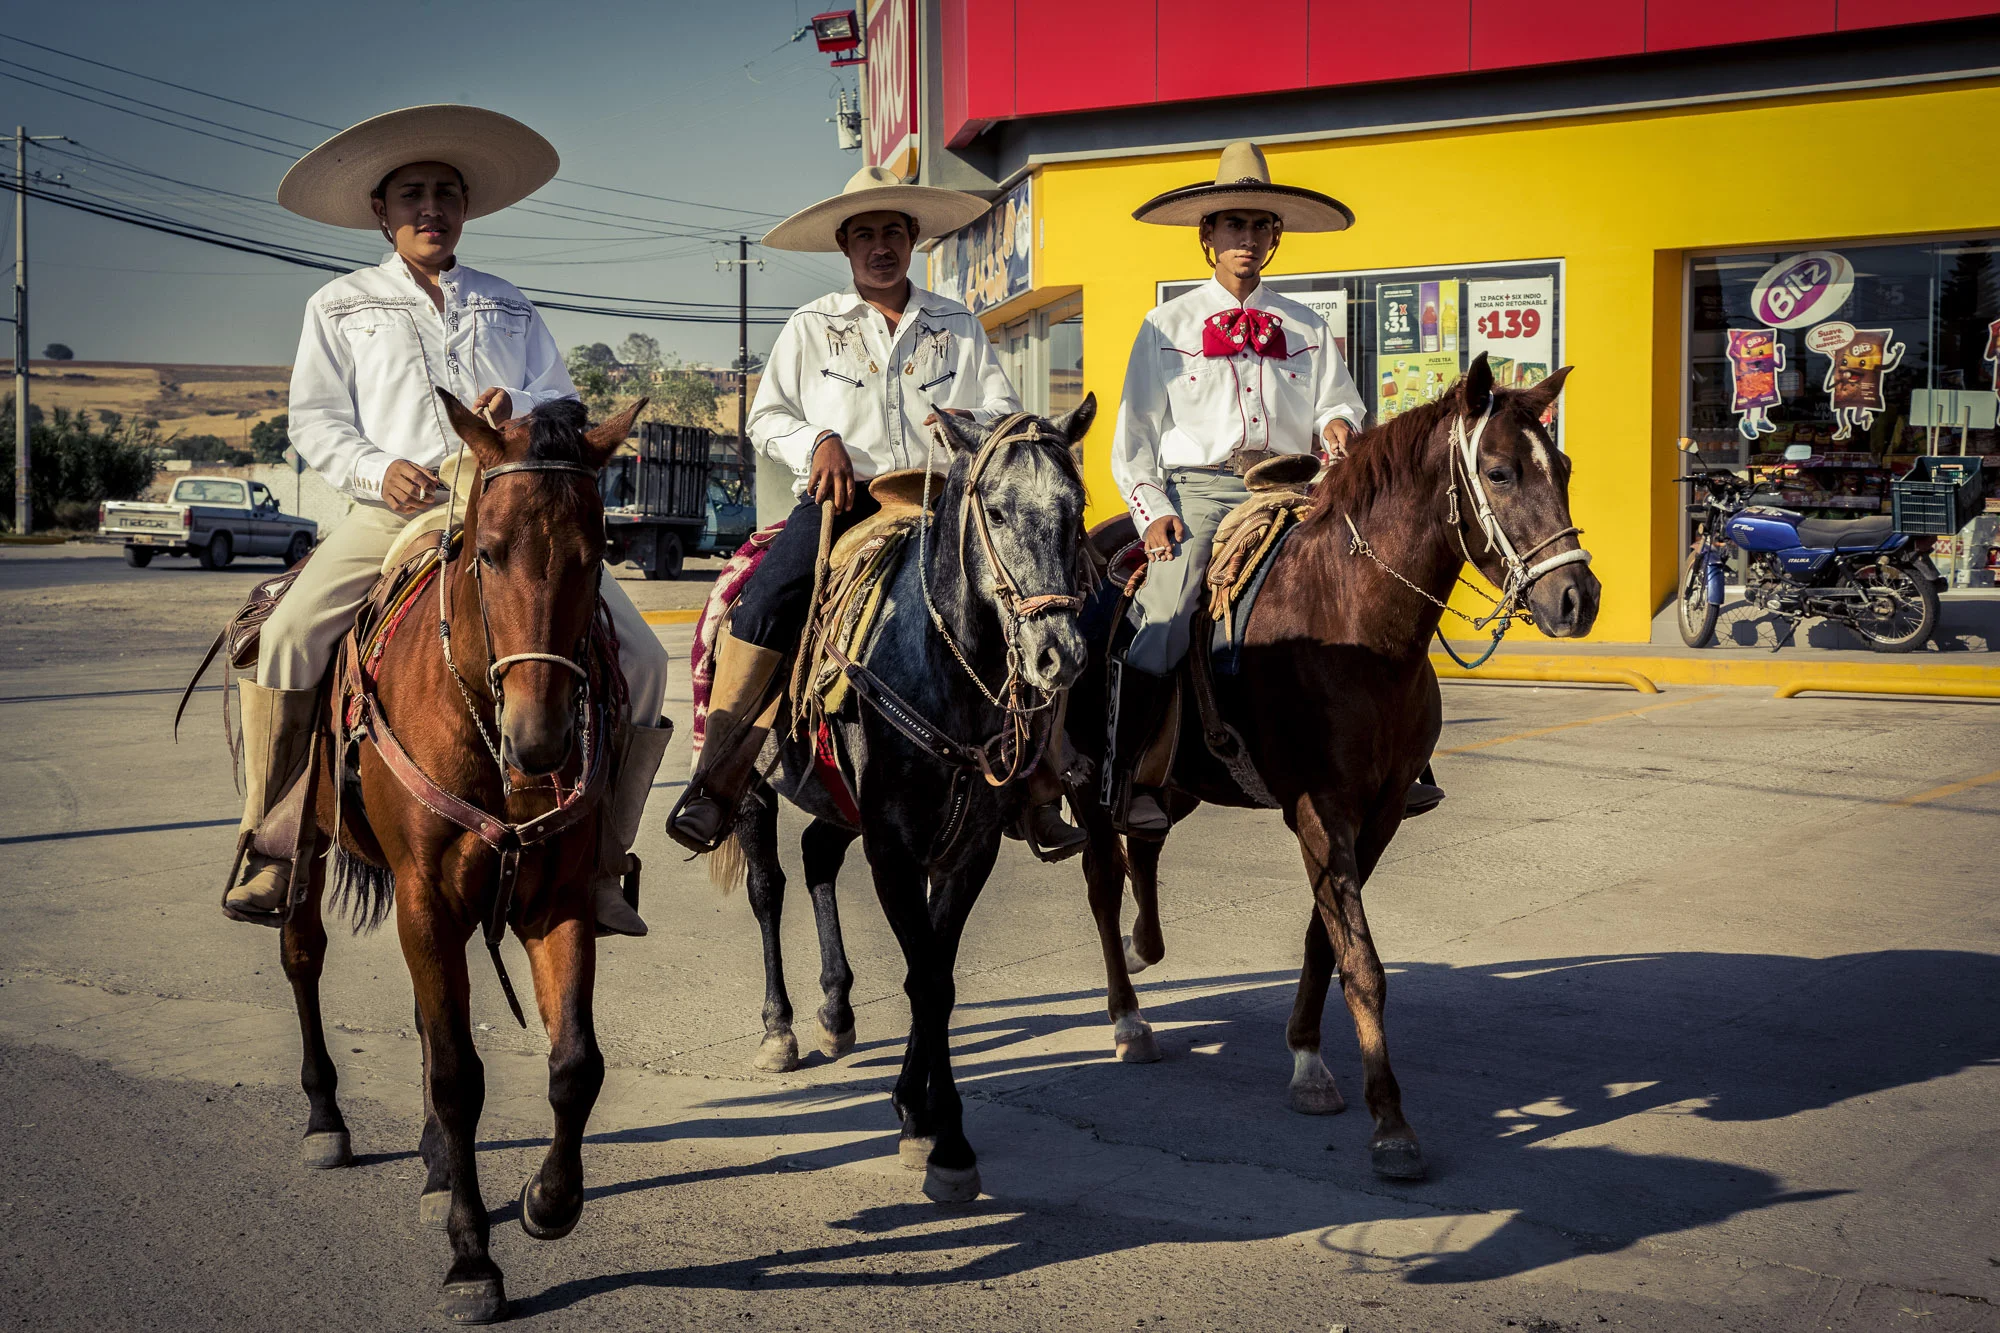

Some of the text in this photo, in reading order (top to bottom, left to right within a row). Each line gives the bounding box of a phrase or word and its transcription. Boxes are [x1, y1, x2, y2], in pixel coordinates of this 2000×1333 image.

[869, 0, 905, 167] OXXO
[1767, 264, 1828, 320] Bitz
[1505, 299, 1548, 307] RETORNABLE
[1384, 316, 1411, 333] $31
[1477, 308, 1541, 339] $139
[1852, 343, 1872, 356] Bitz
[120, 518, 168, 528] mazda
